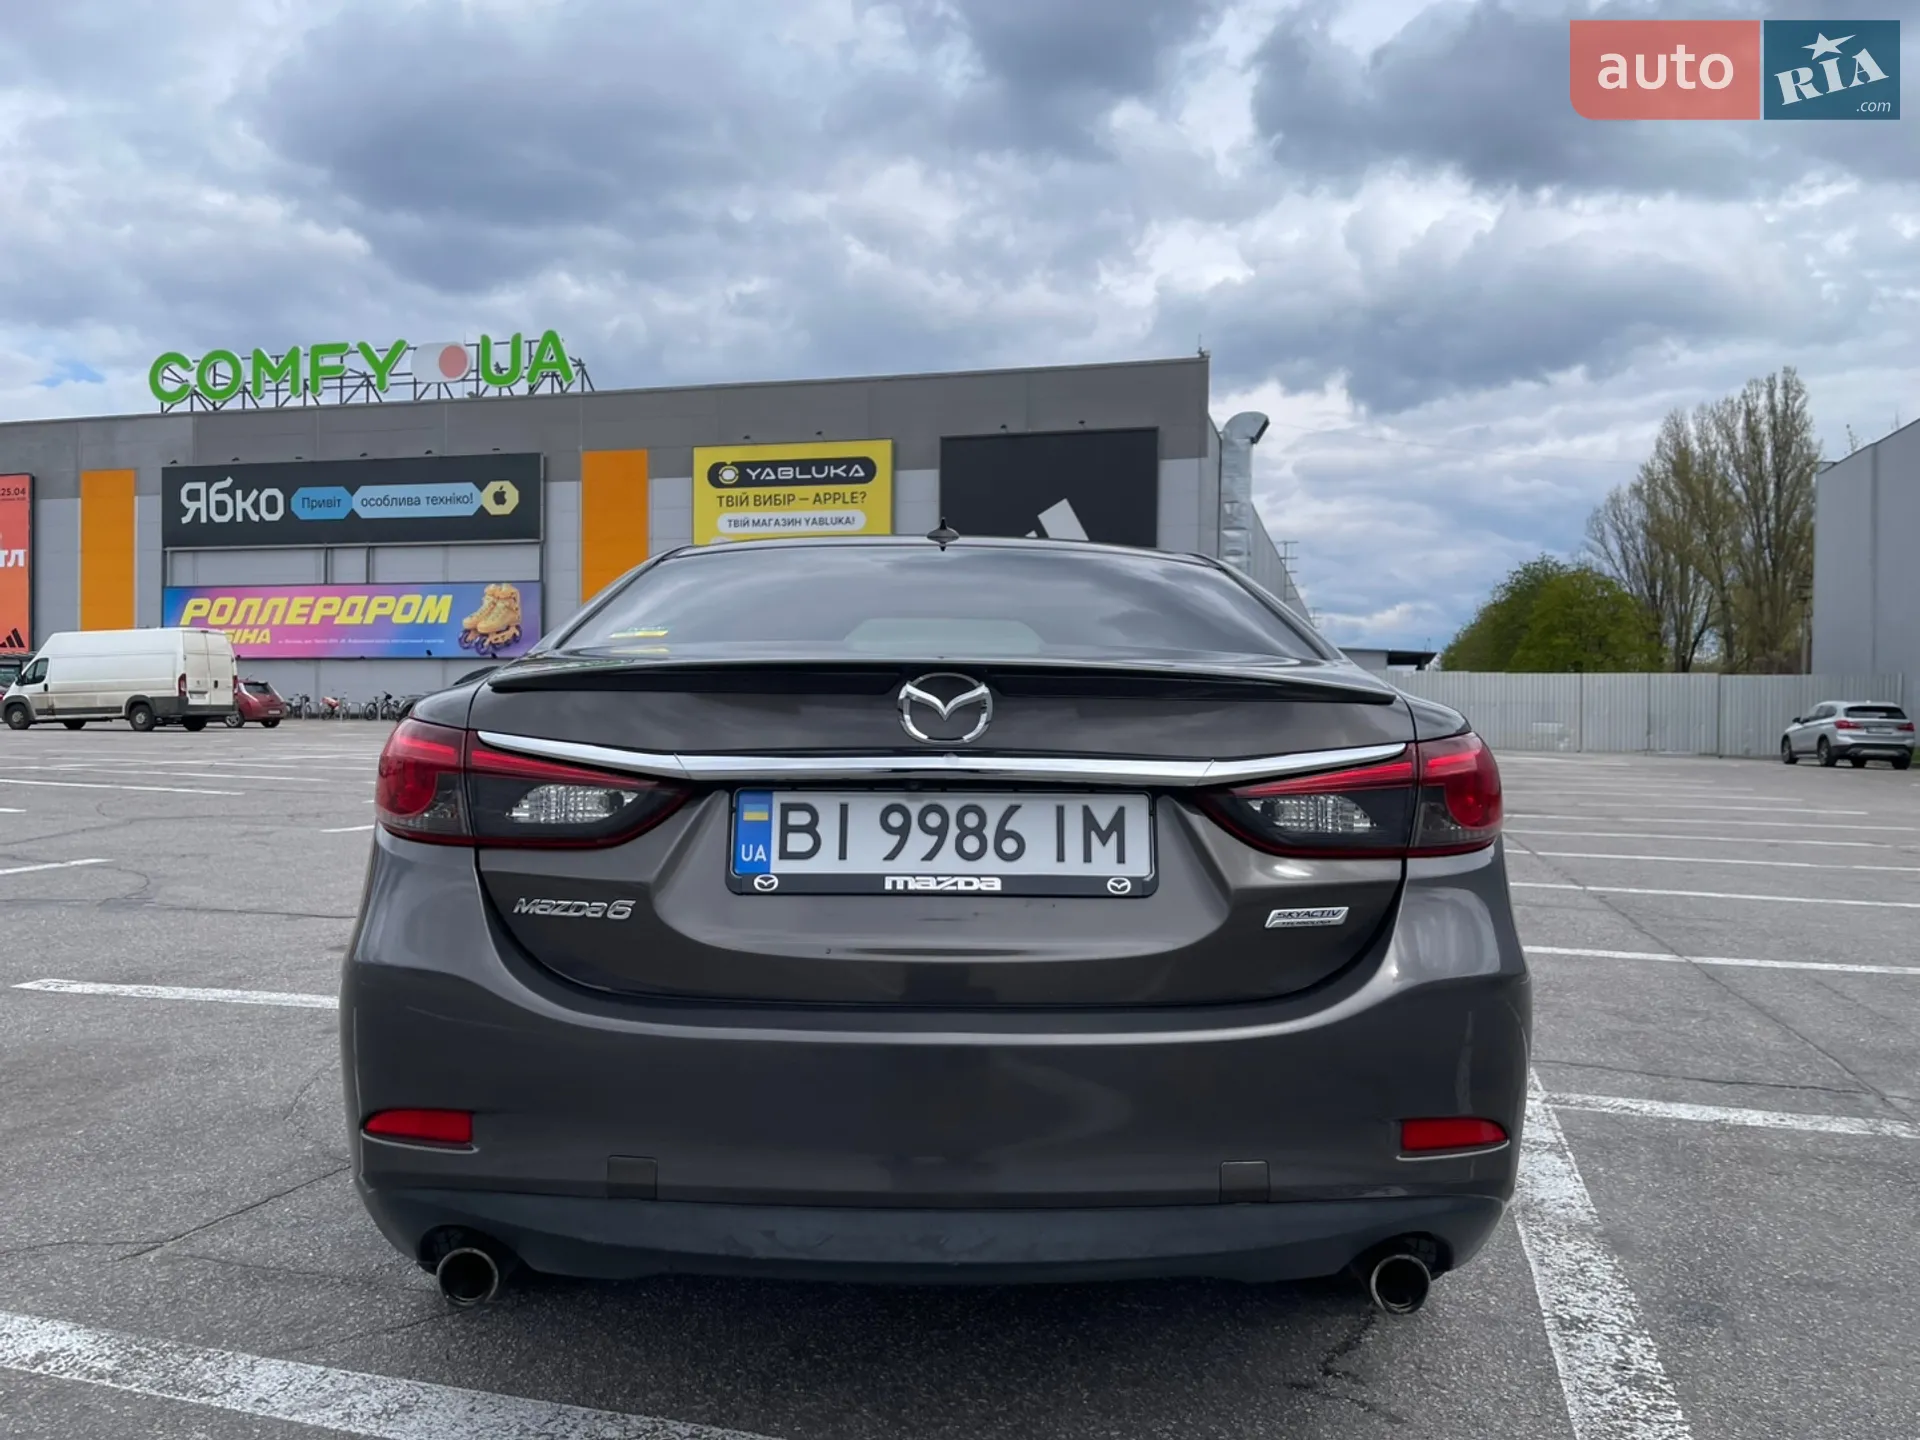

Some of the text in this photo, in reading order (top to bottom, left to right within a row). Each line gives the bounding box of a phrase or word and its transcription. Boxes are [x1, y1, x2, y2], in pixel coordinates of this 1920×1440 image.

[149, 329, 576, 403] COMFY UA
[745, 464, 865, 481] YABLUKA
[180, 476, 474, 525] Ябко Привіт особлива техніко!
[716, 493, 749, 508] ТВІЙ
[753, 493, 795, 507] ВИБІР
[812, 491, 867, 505] APPLE?
[727, 516, 855, 528] ТВІЙ МАГАЗИН YABLUKA!
[179, 594, 453, 626] РОЛЛЕРДРОМ
[778, 802, 1126, 864] BI 9986 IM
[741, 844, 767, 862] UA
